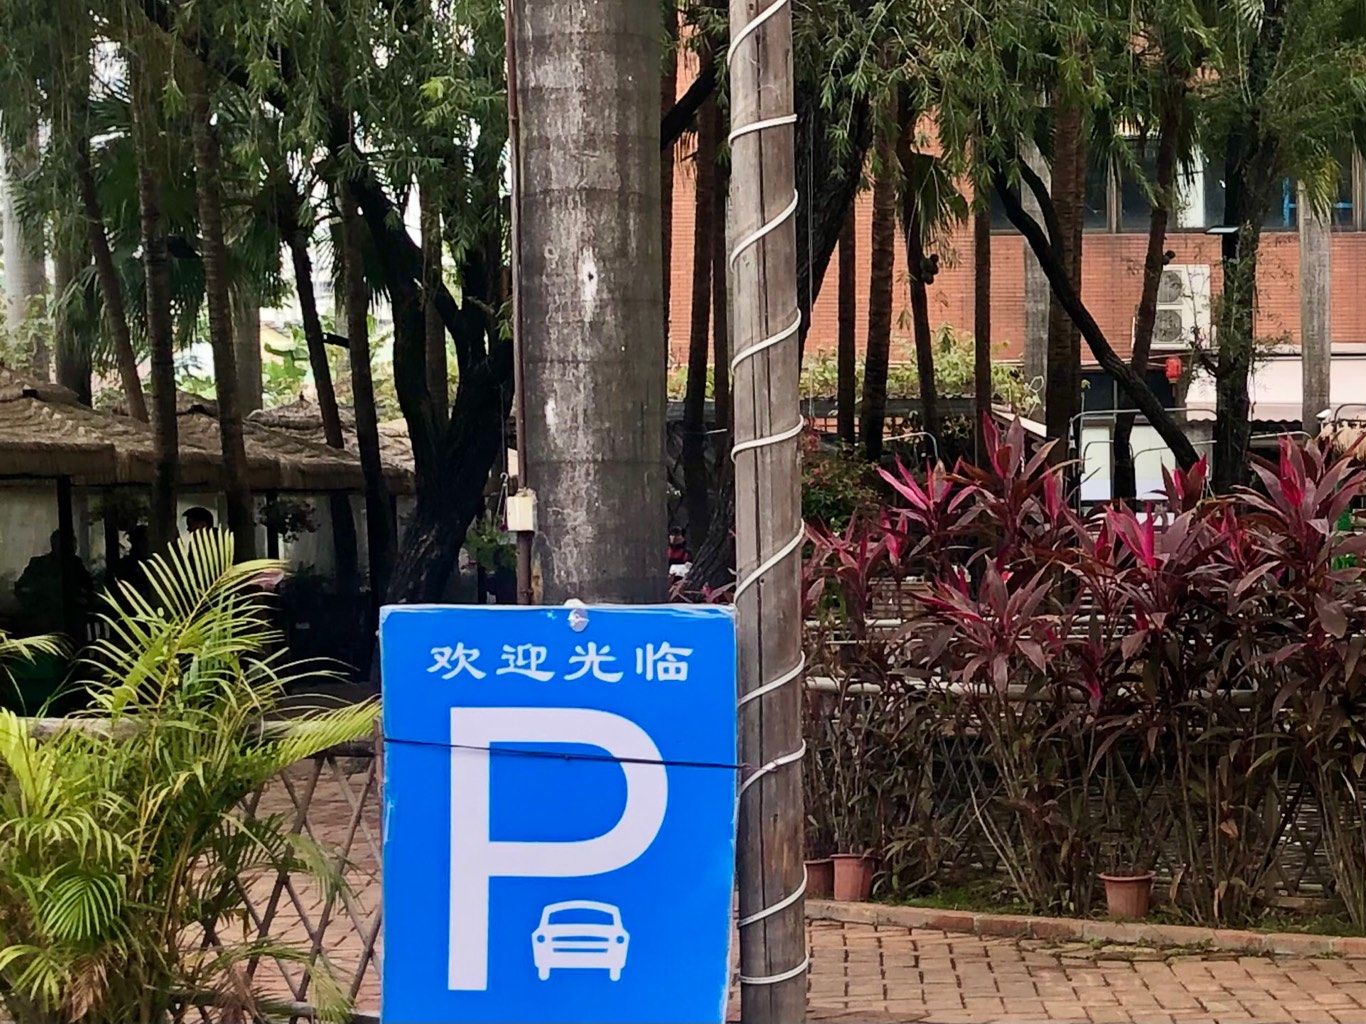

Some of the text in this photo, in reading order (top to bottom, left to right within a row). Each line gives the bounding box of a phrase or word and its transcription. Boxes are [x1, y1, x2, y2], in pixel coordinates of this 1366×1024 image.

[426, 641, 694, 682] 欢迎光临
[448, 707, 668, 991] P
